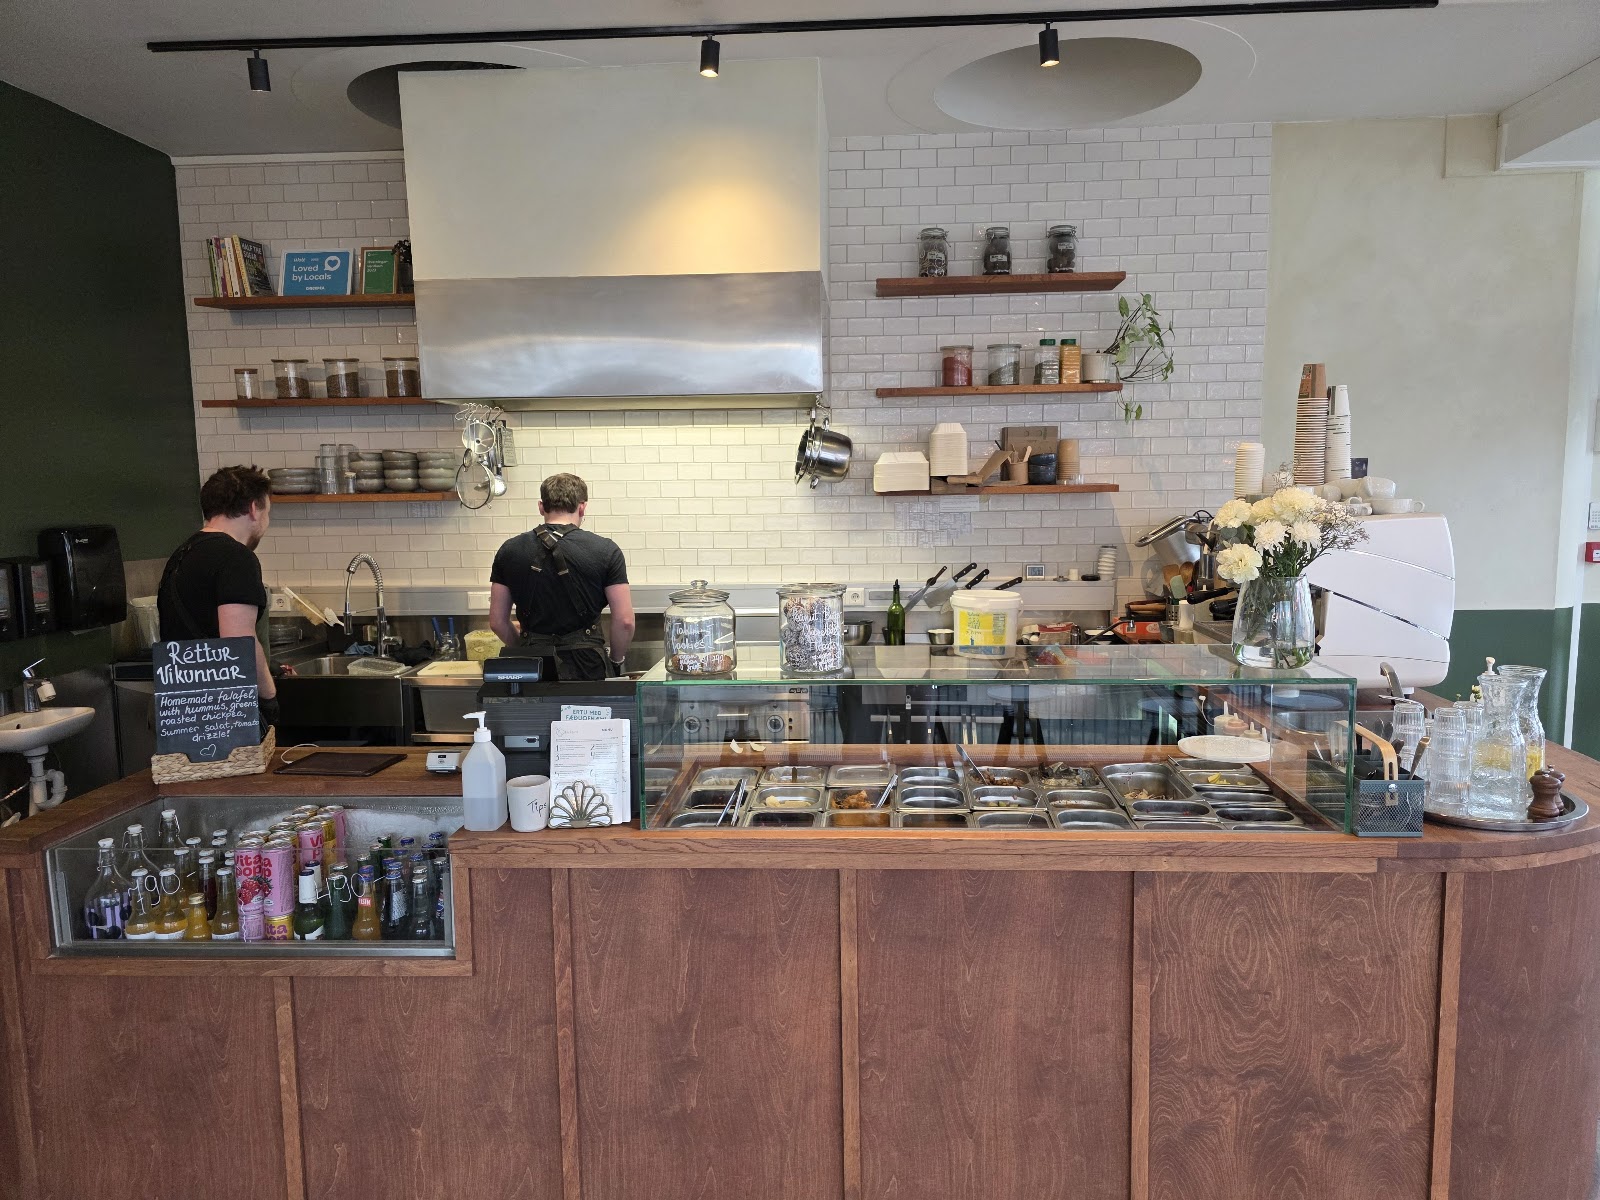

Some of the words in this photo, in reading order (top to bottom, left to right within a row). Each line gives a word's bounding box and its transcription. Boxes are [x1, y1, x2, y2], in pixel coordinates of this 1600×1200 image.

[292, 264, 319, 272] Loved
[292, 274, 303, 283] by
[304, 272, 332, 281] Locals
[160, 693, 214, 708] Homemade
[217, 689, 256, 703] falafel,
[160, 706, 181, 717] with
[185, 702, 229, 715] hummus,
[160, 714, 197, 727] roasted
[201, 710, 247, 721] chickpea,
[192, 729, 231, 742] drizzle!
[527, 799, 547, 817] Tips
